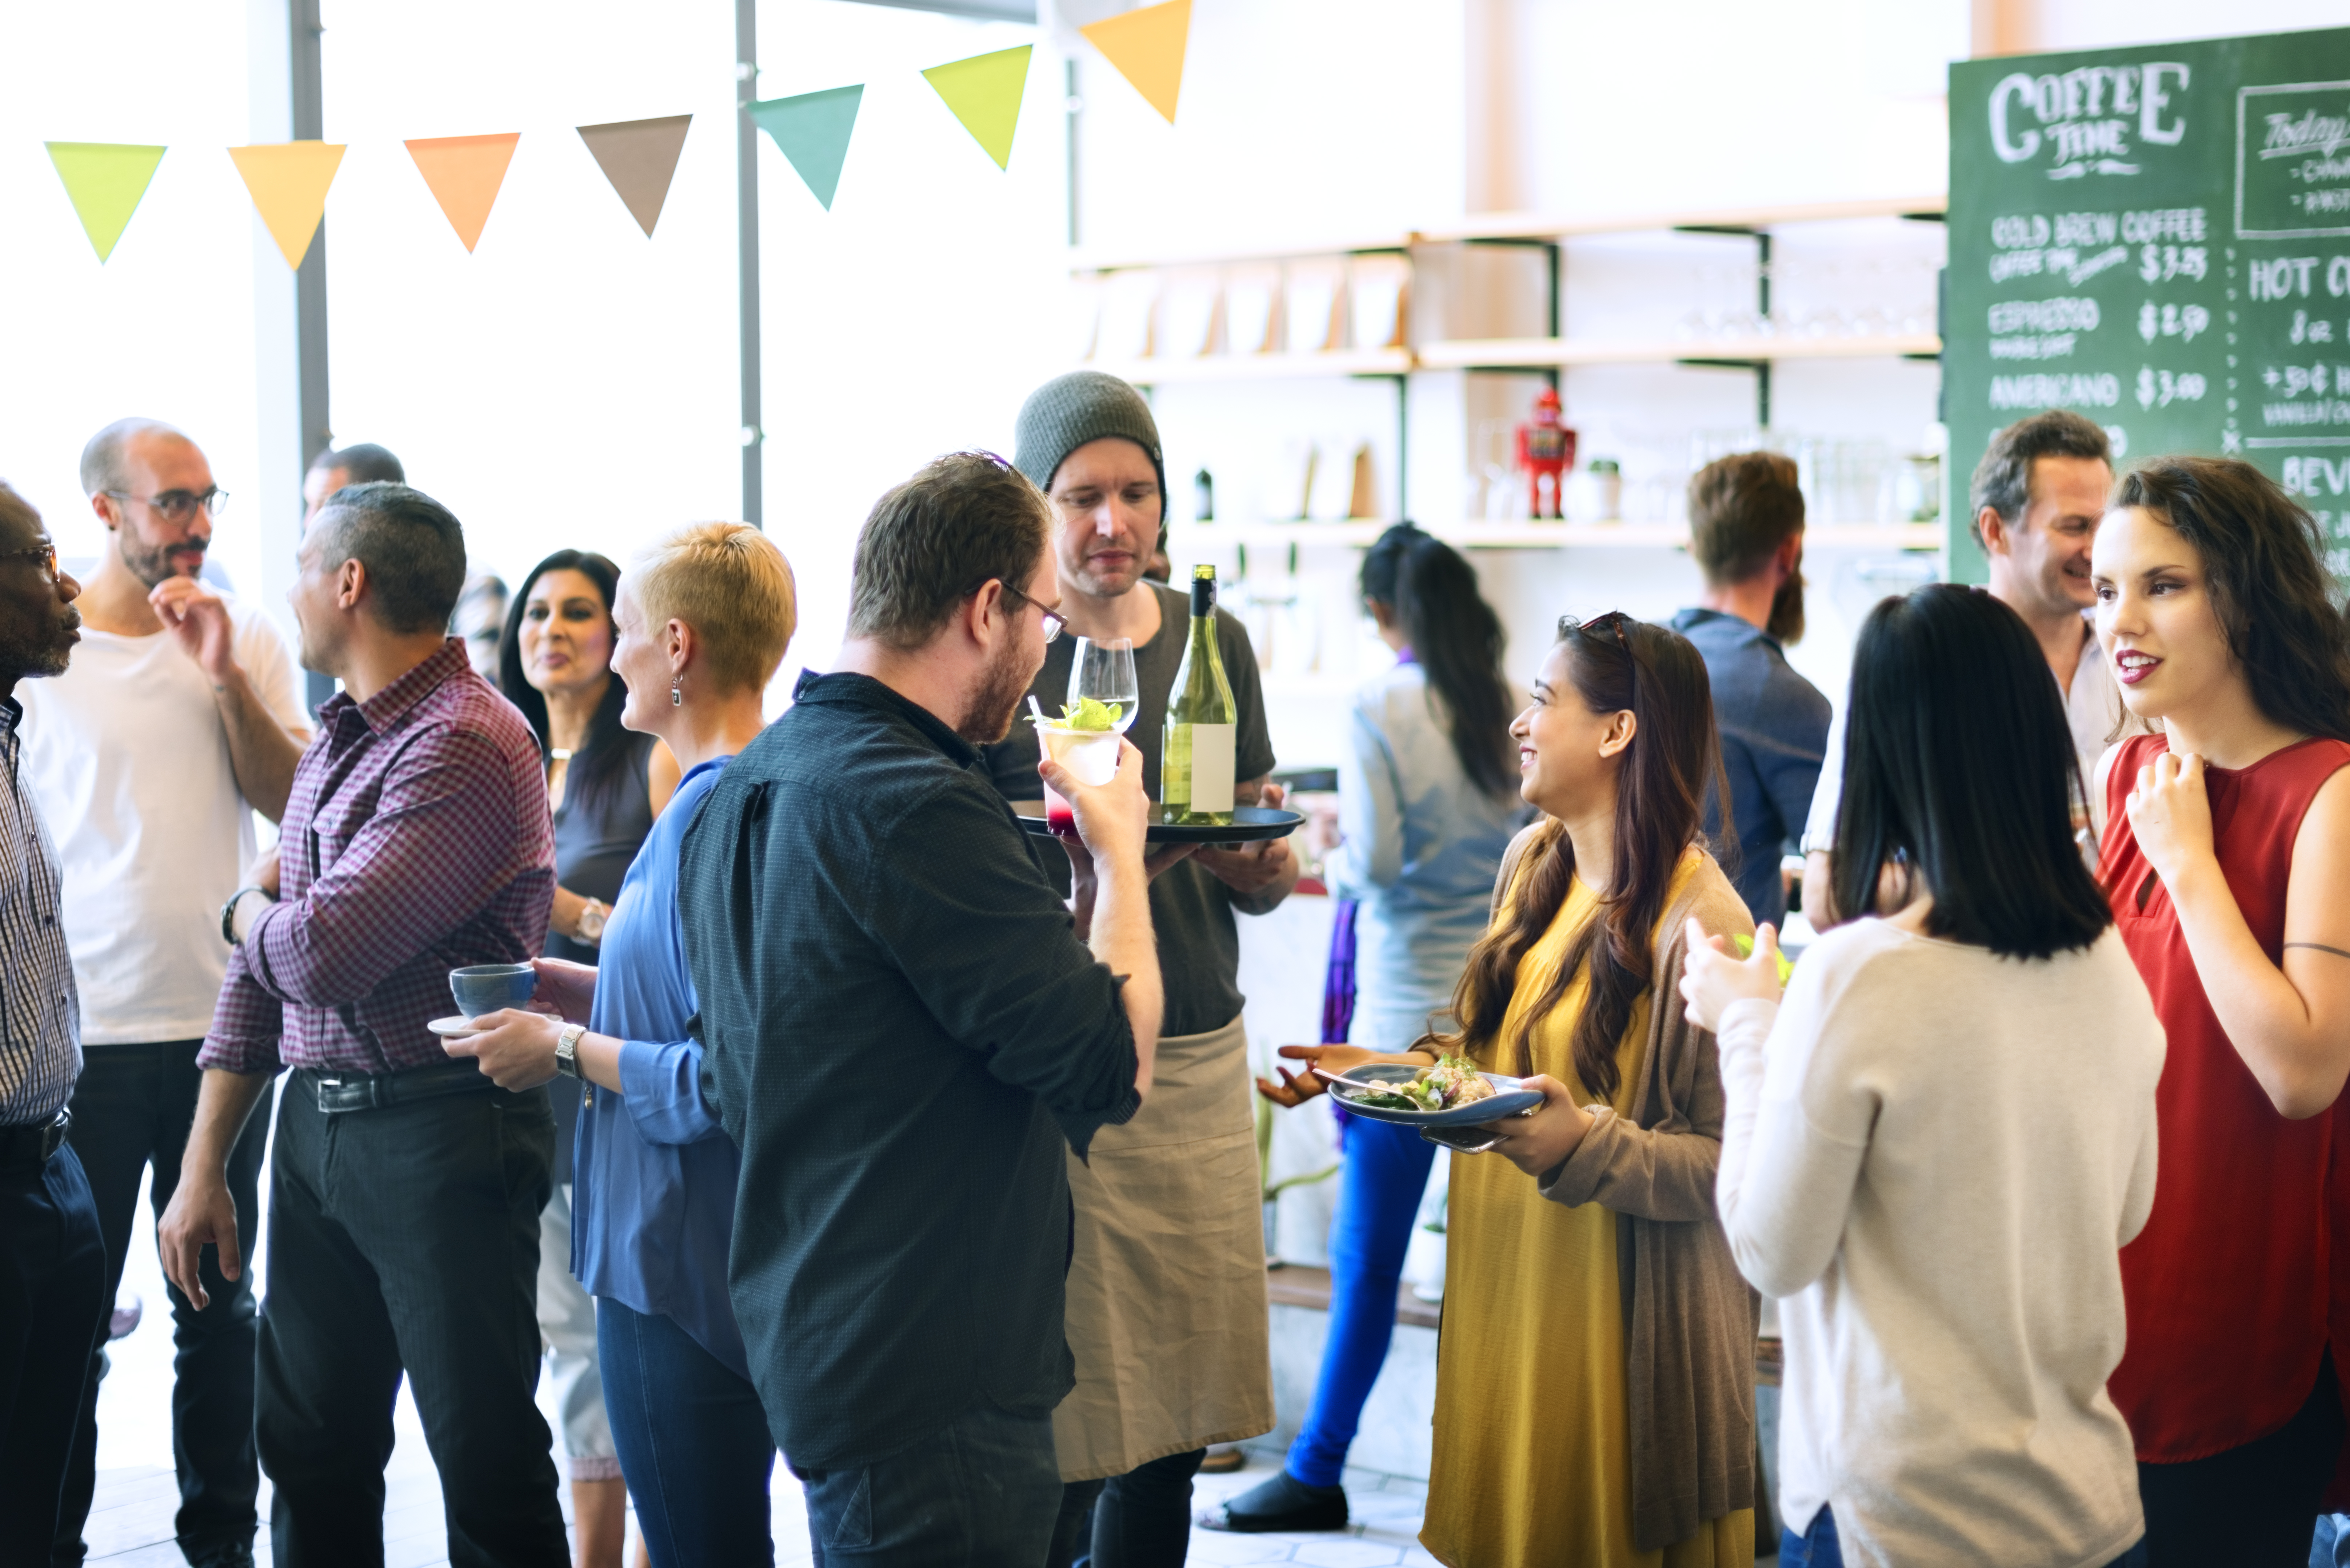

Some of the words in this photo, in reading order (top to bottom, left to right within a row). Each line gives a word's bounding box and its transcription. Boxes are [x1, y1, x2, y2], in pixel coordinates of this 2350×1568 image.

[1989, 62, 2190, 163] COFFEE
[2263, 109, 2350, 158] Today
[2045, 119, 2129, 167] TIME
[1992, 215, 2051, 249] COLD
[2054, 212, 2117, 247] BREW
[2121, 207, 2206, 244] COFFEE
[2249, 256, 2319, 301] HOT
[1988, 296, 2100, 333] ESPRESSO
[1989, 373, 2119, 410] AMERICANO
[2283, 455, 2350, 497] BEV
